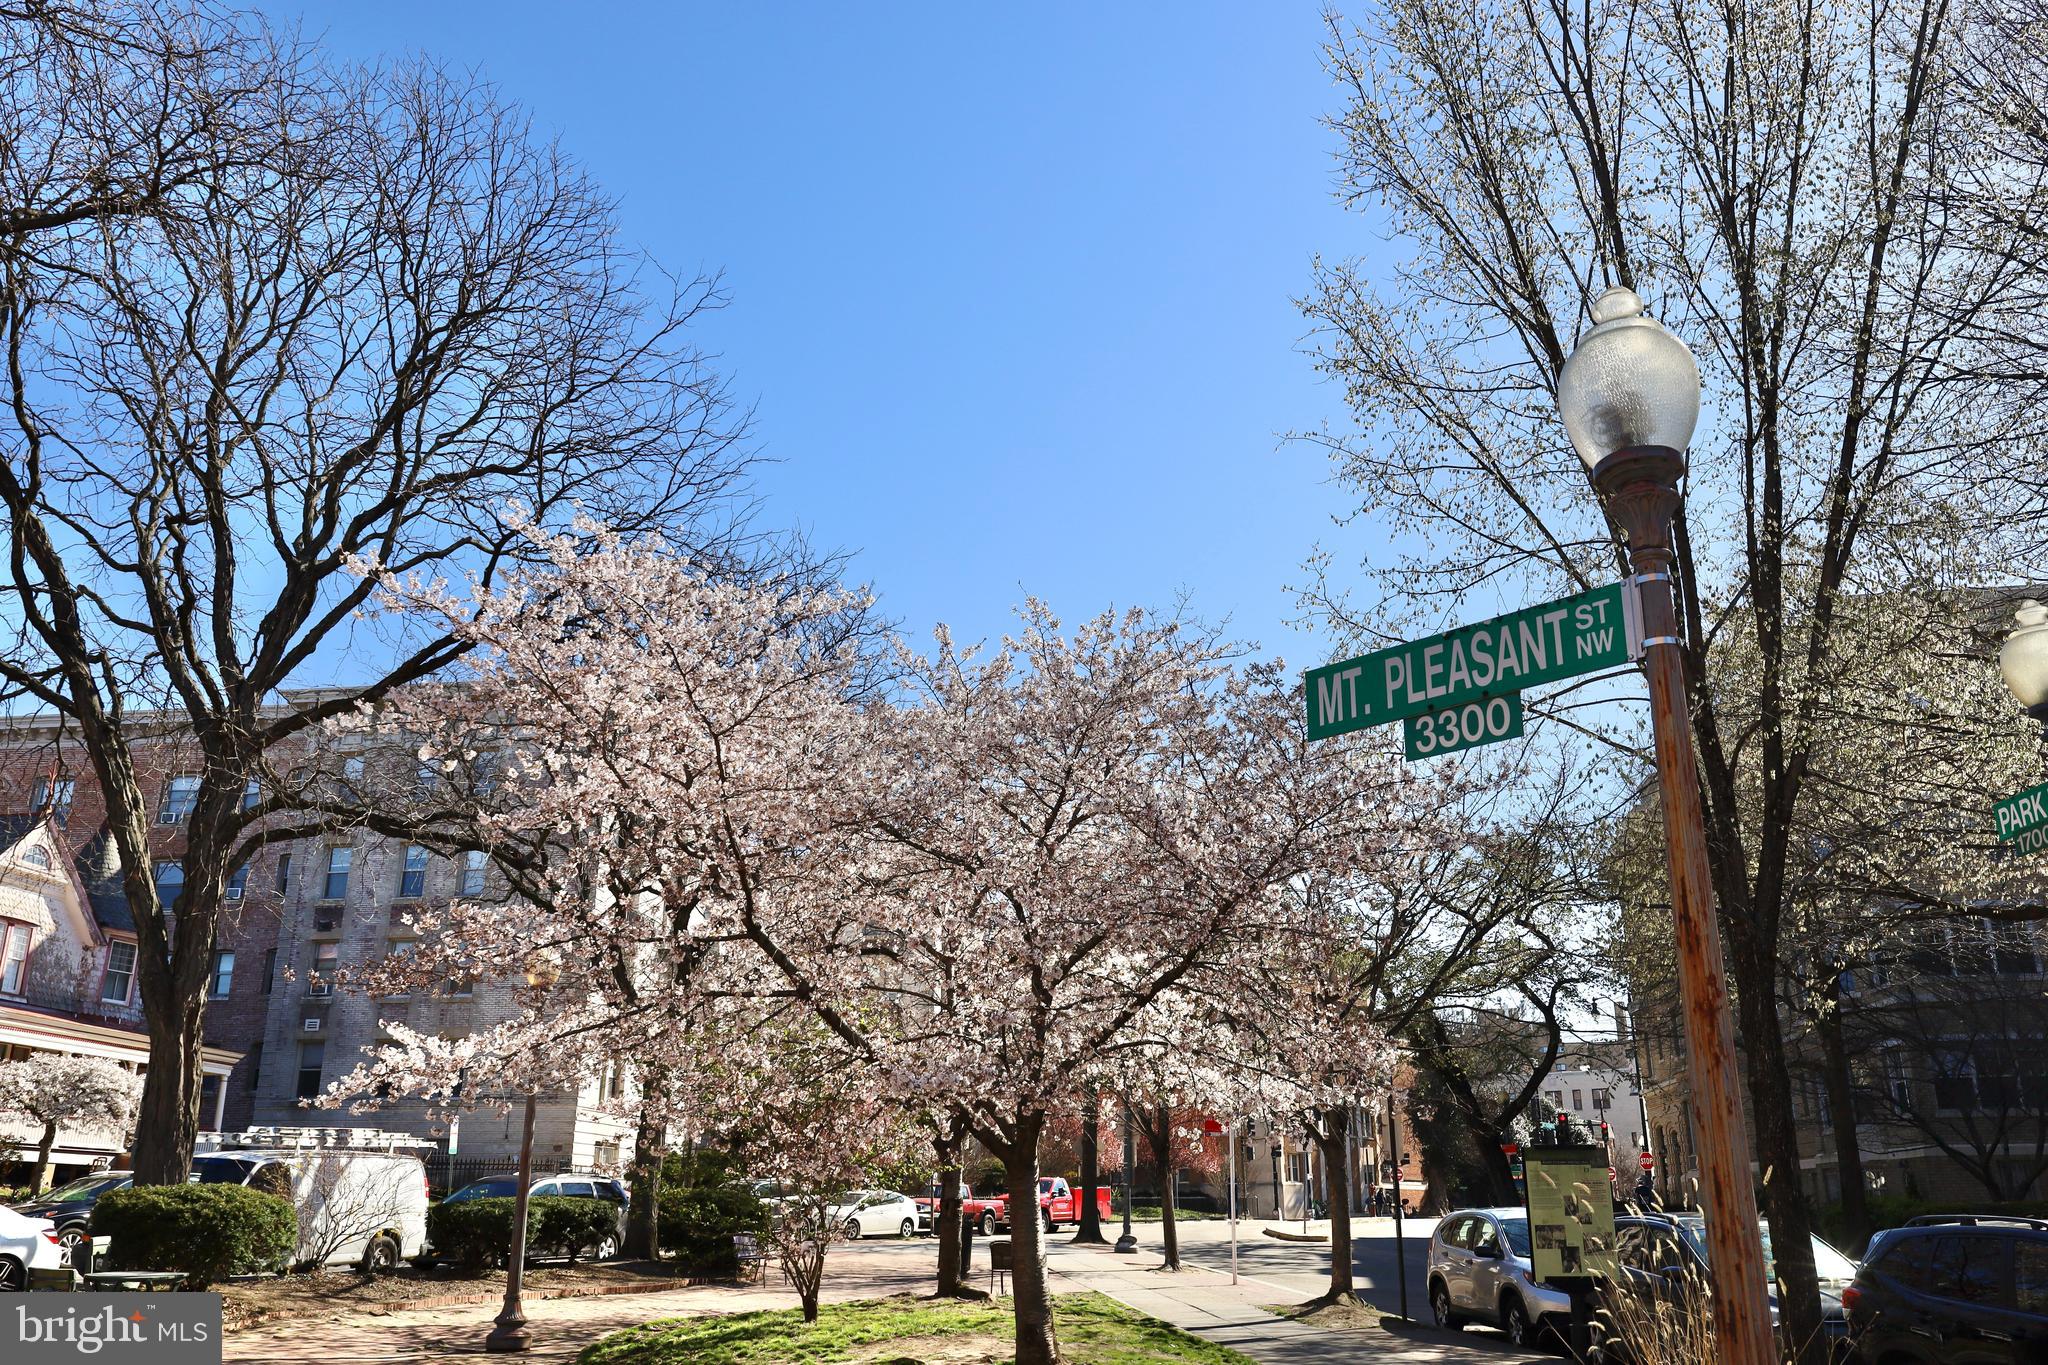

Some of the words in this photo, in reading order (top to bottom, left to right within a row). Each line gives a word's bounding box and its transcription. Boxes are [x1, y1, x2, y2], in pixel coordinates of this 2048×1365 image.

[1317, 667, 1370, 726] MT.
[1385, 609, 1568, 709] PLEASANT
[1575, 598, 1610, 630] ST
[1576, 627, 1614, 659] NW
[1415, 697, 1511, 752] 3300
[1998, 792, 2048, 835] PARK
